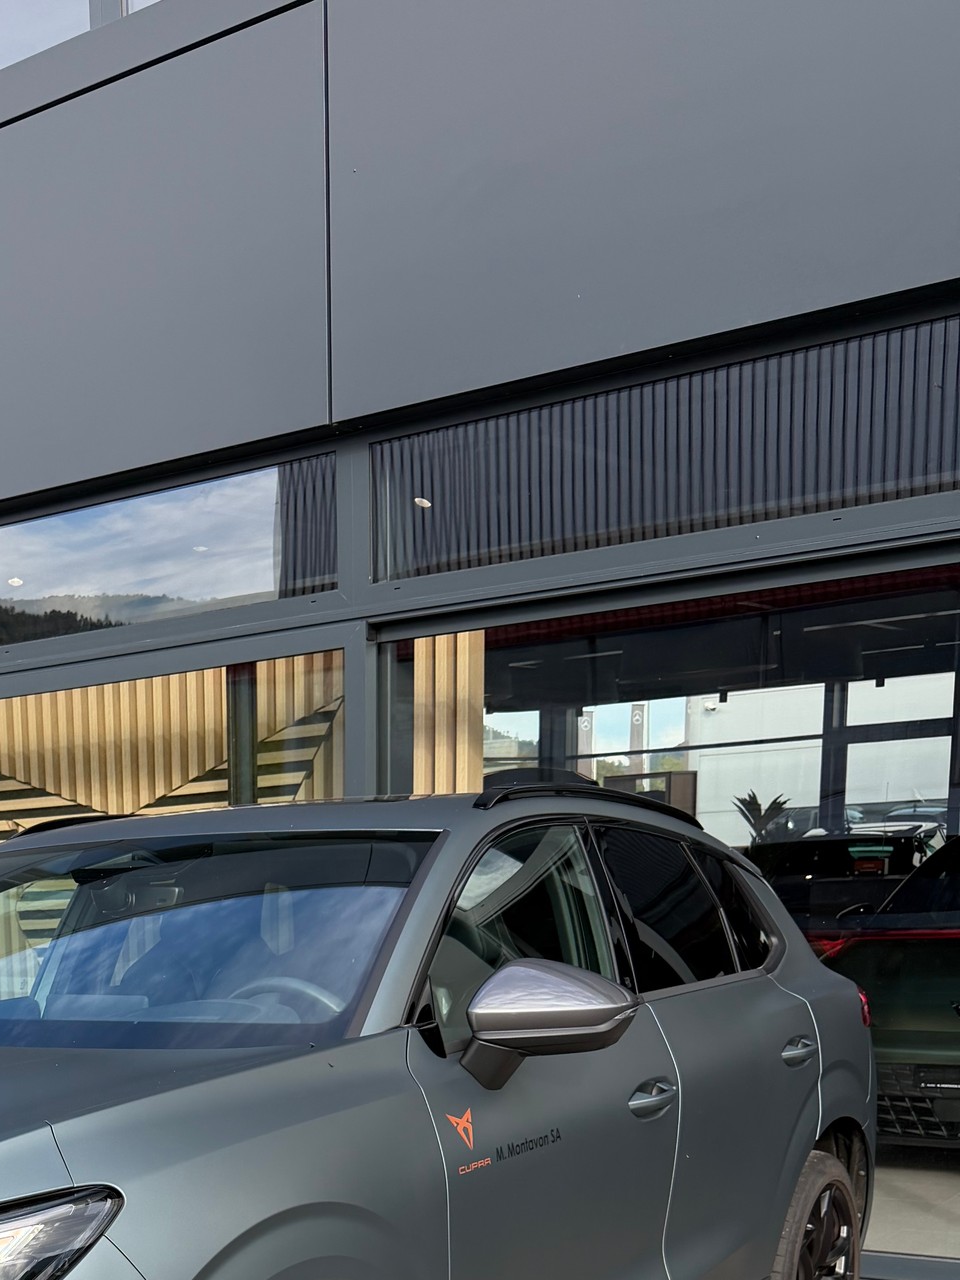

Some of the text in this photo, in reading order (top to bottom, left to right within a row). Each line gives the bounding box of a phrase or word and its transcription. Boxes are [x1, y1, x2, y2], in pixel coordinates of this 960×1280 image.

[496, 1127, 562, 1162] M. Montavon SA
[459, 1158, 491, 1174] CUPRA
